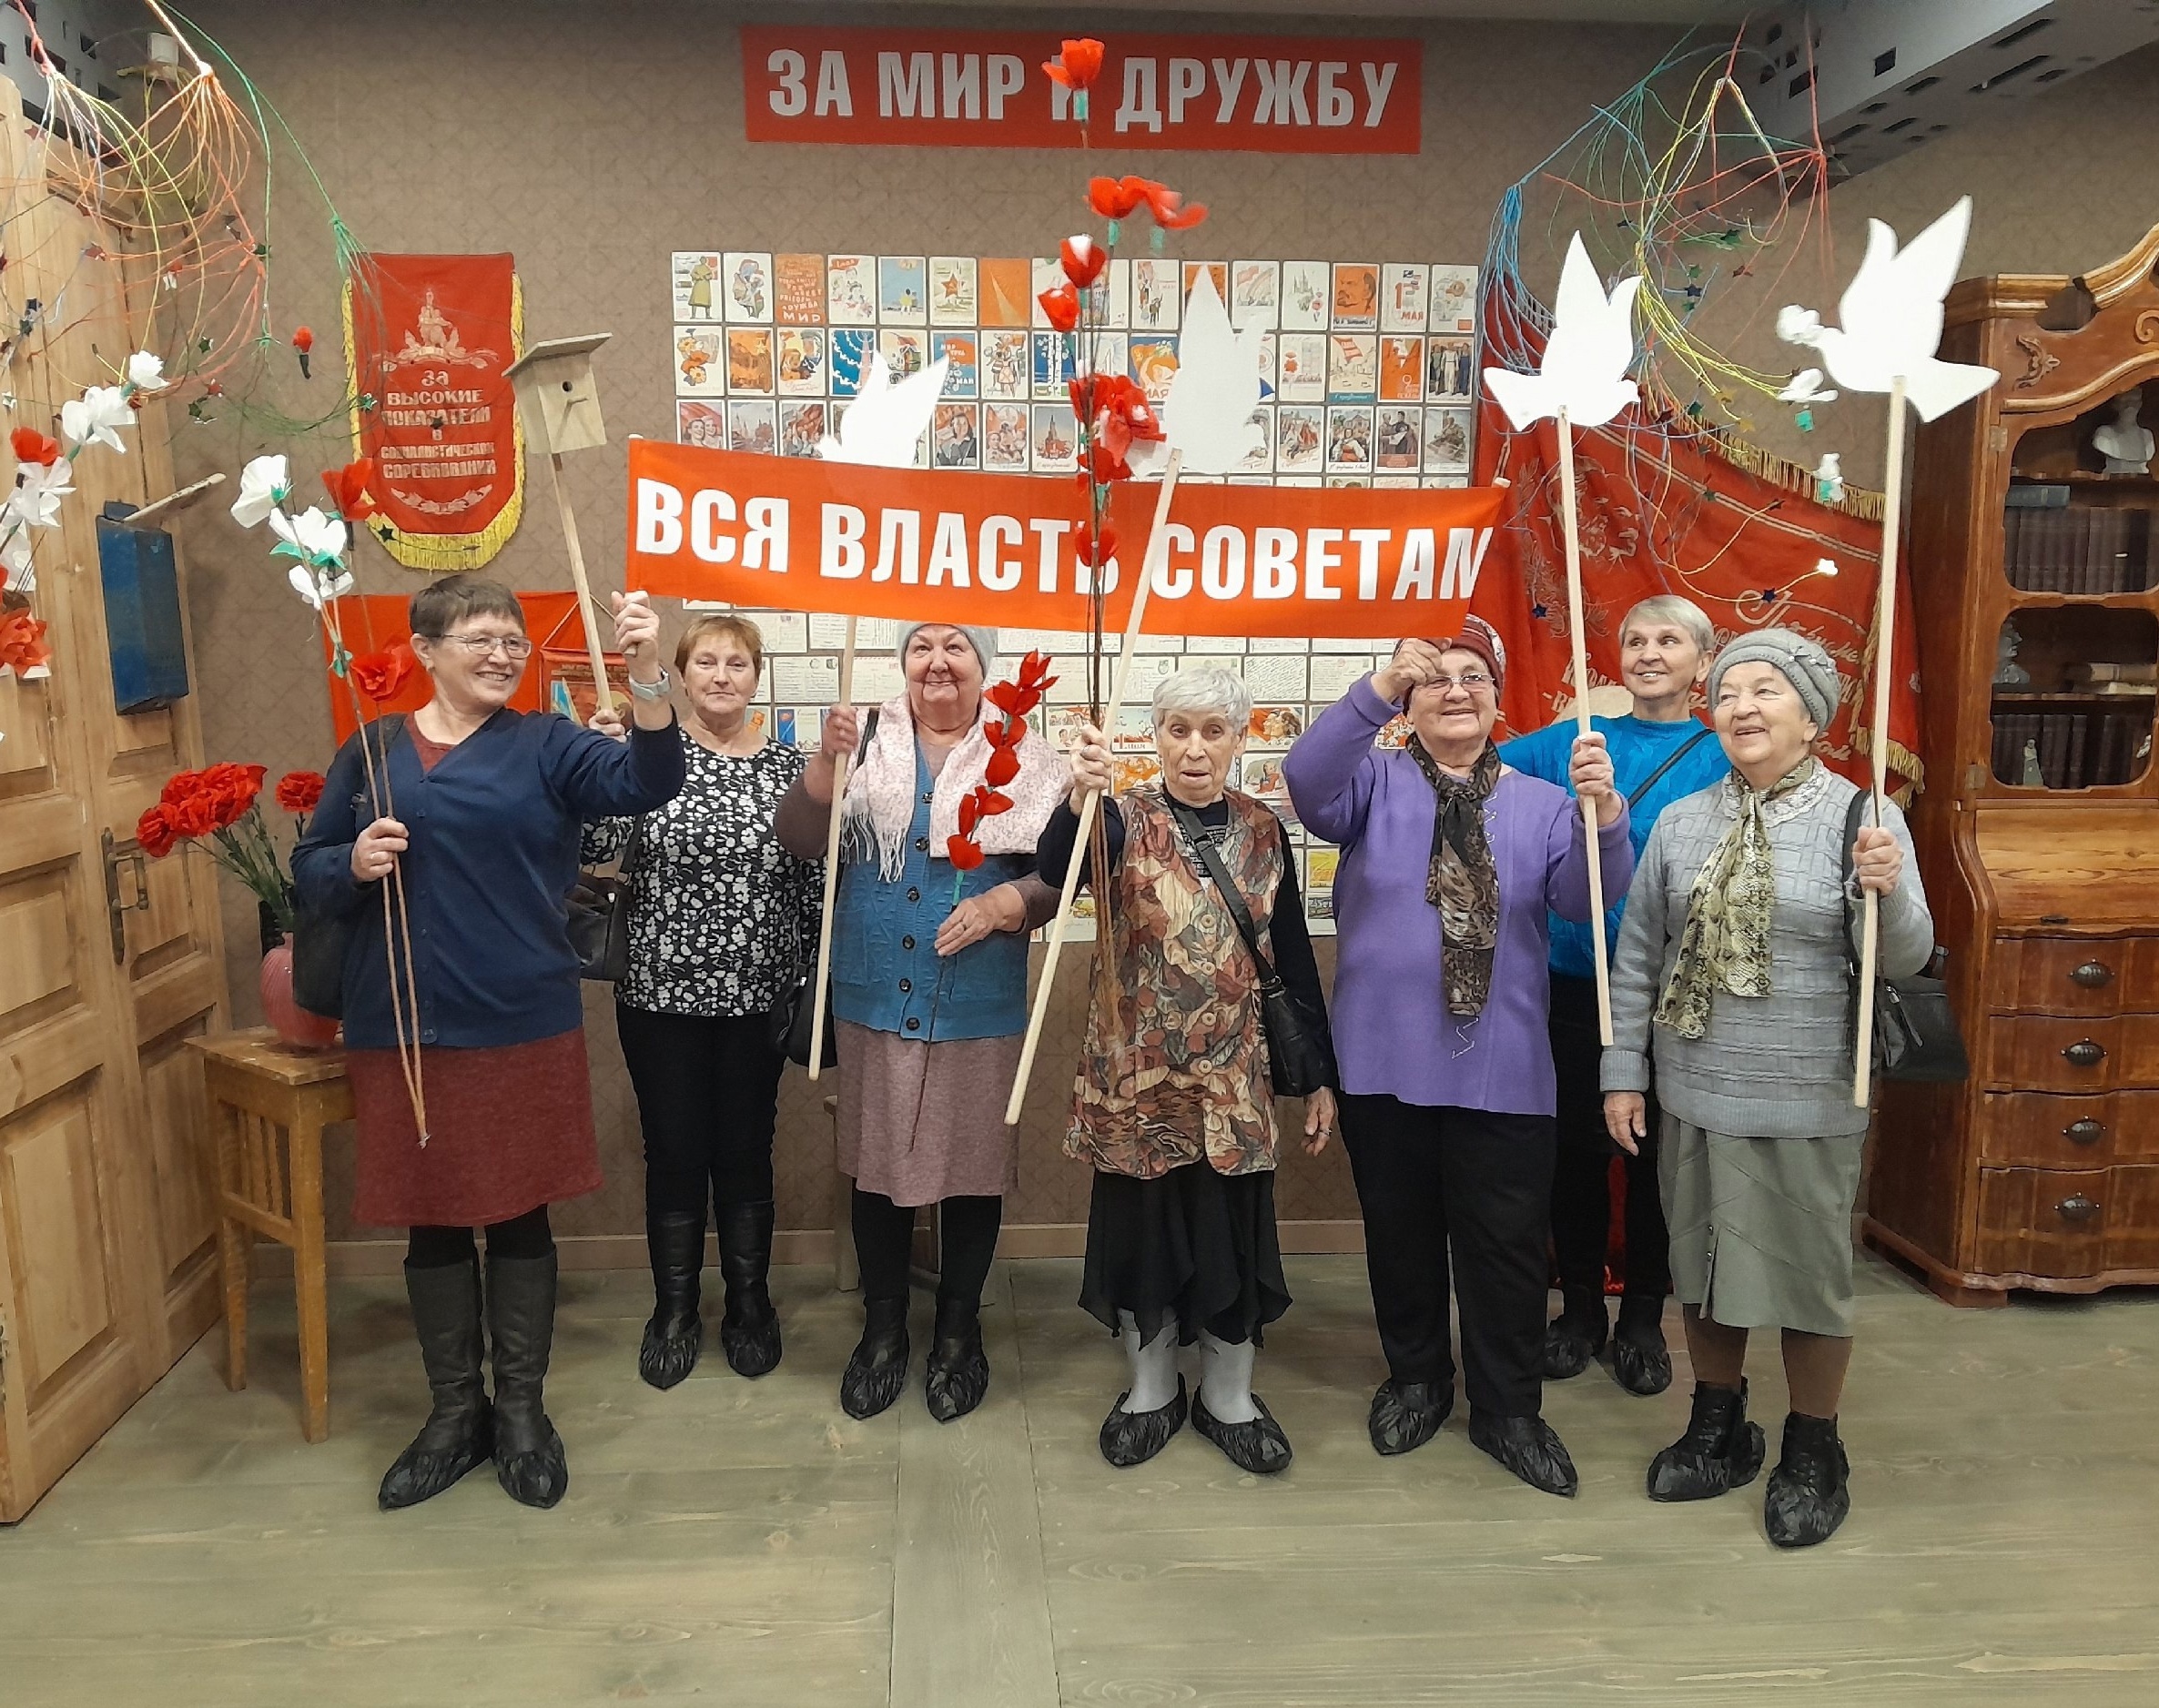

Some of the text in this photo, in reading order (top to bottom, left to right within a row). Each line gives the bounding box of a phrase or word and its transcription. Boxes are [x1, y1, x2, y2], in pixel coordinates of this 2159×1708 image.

[767, 48, 854, 116] ЗА
[877, 51, 1026, 120] МИР
[1114, 56, 1399, 133] ДРУЖБУ
[783, 310, 821, 323] МИР
[1401, 310, 1424, 320] МАЯ
[421, 369, 450, 387] ЗА
[387, 389, 484, 406] ВЫСОКИЕ
[381, 406, 492, 427] ПОКАЗАТЕЛИ
[635, 477, 1495, 601] ВСЯ ВЛАСТЬ СОВЕТАМ
